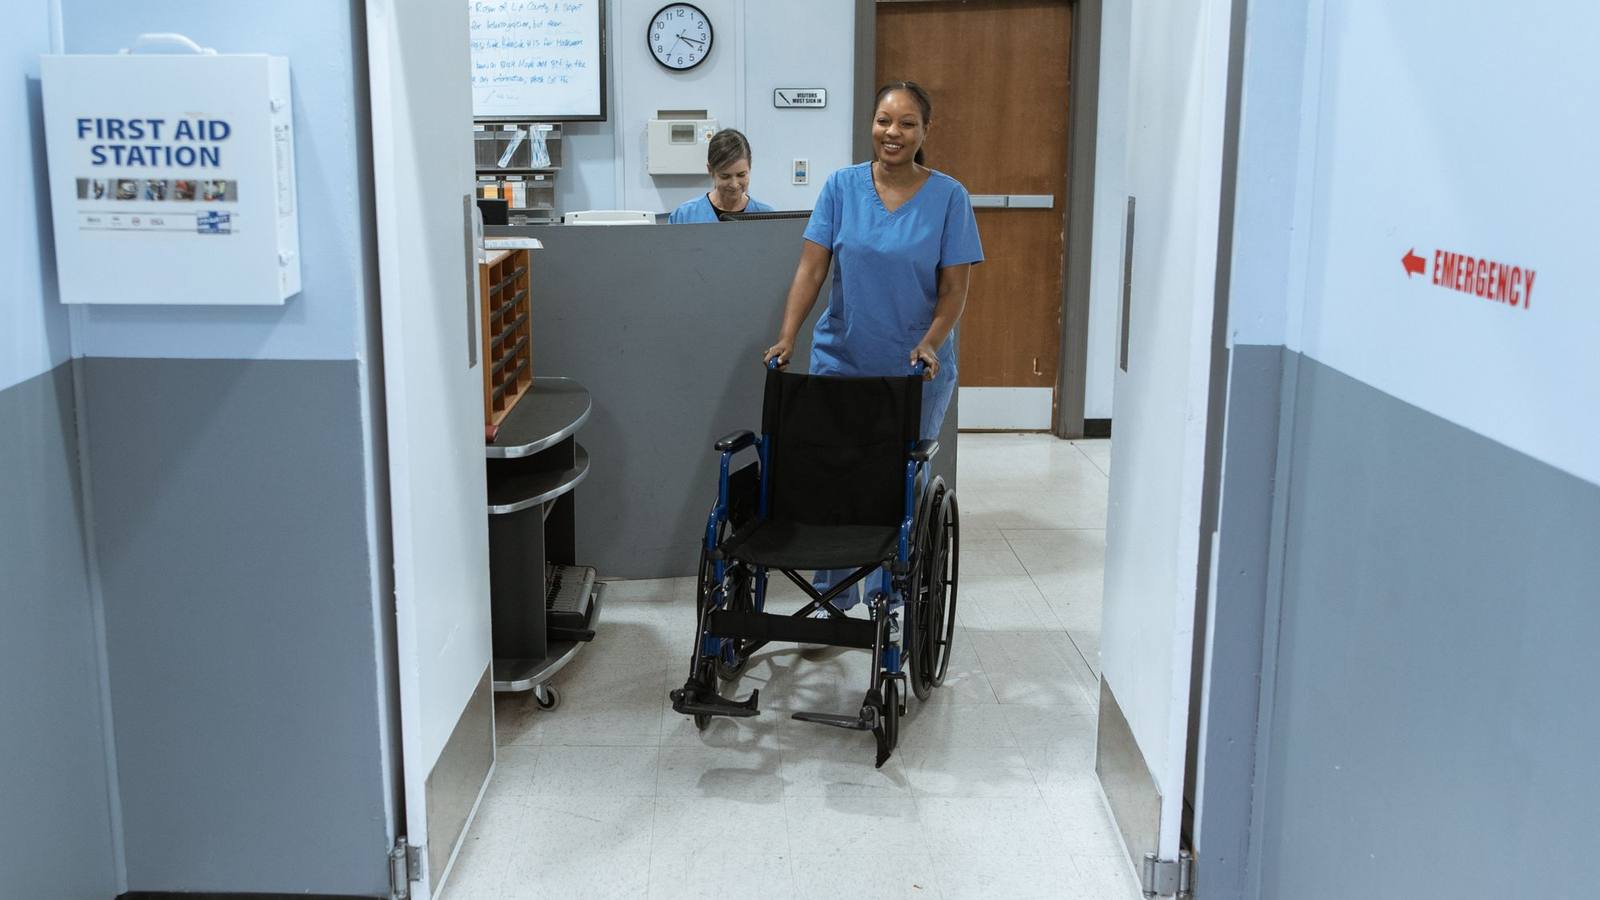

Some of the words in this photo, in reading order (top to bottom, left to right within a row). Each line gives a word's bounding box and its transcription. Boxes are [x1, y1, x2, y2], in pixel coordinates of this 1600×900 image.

[666, 12, 673, 21] 11
[676, 9, 685, 17] 12
[656, 21, 665, 30] 10
[697, 21, 704, 30] 2
[654, 33, 660, 41] 9
[700, 33, 707, 41] 3
[657, 45, 663, 53] 8
[697, 45, 703, 53] 4
[666, 53, 672, 61] 7
[677, 57, 683, 65] 6
[689, 53, 695, 62] 5
[77, 118, 165, 141] FIRST
[174, 119, 231, 142] AID
[91, 145, 221, 167] STATION
[1433, 249, 1536, 310] EMERGENCY
